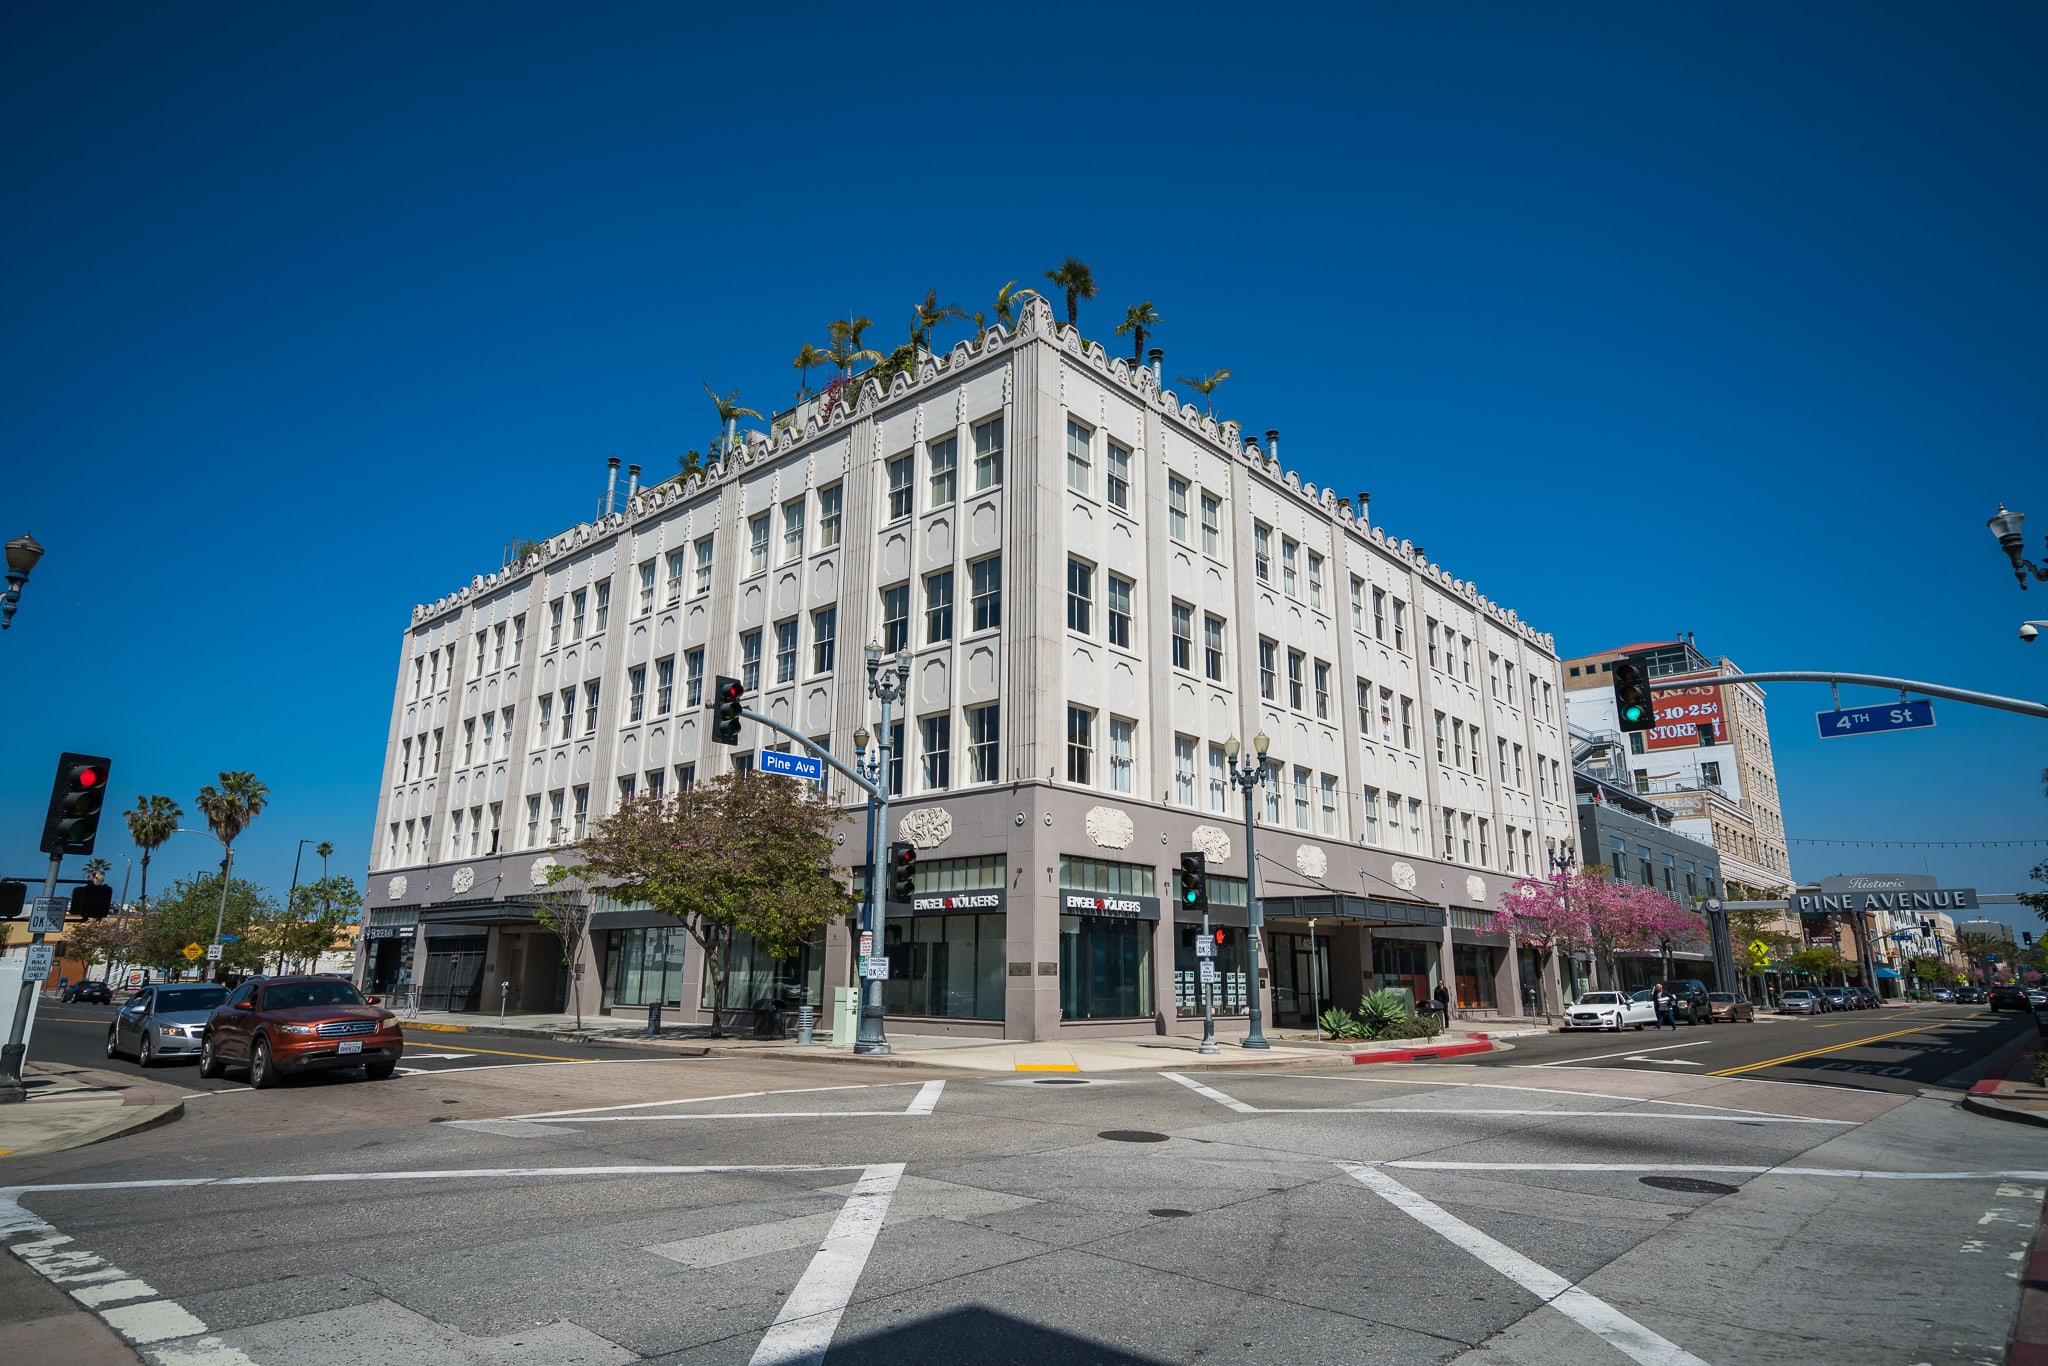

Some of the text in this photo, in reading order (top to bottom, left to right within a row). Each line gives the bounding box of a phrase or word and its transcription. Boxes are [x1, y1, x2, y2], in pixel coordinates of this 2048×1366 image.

[1836, 708, 1913, 729] 4TH St
[1649, 722, 1697, 740] STORE
[767, 755, 816, 774] Pine Ave
[1848, 876, 1905, 889] Historic
[1800, 891, 1967, 911] PINE AVENUE
[32, 915, 46, 928] OK
[868, 968, 877, 977] OK
[1814, 1062, 1913, 1076] PED
